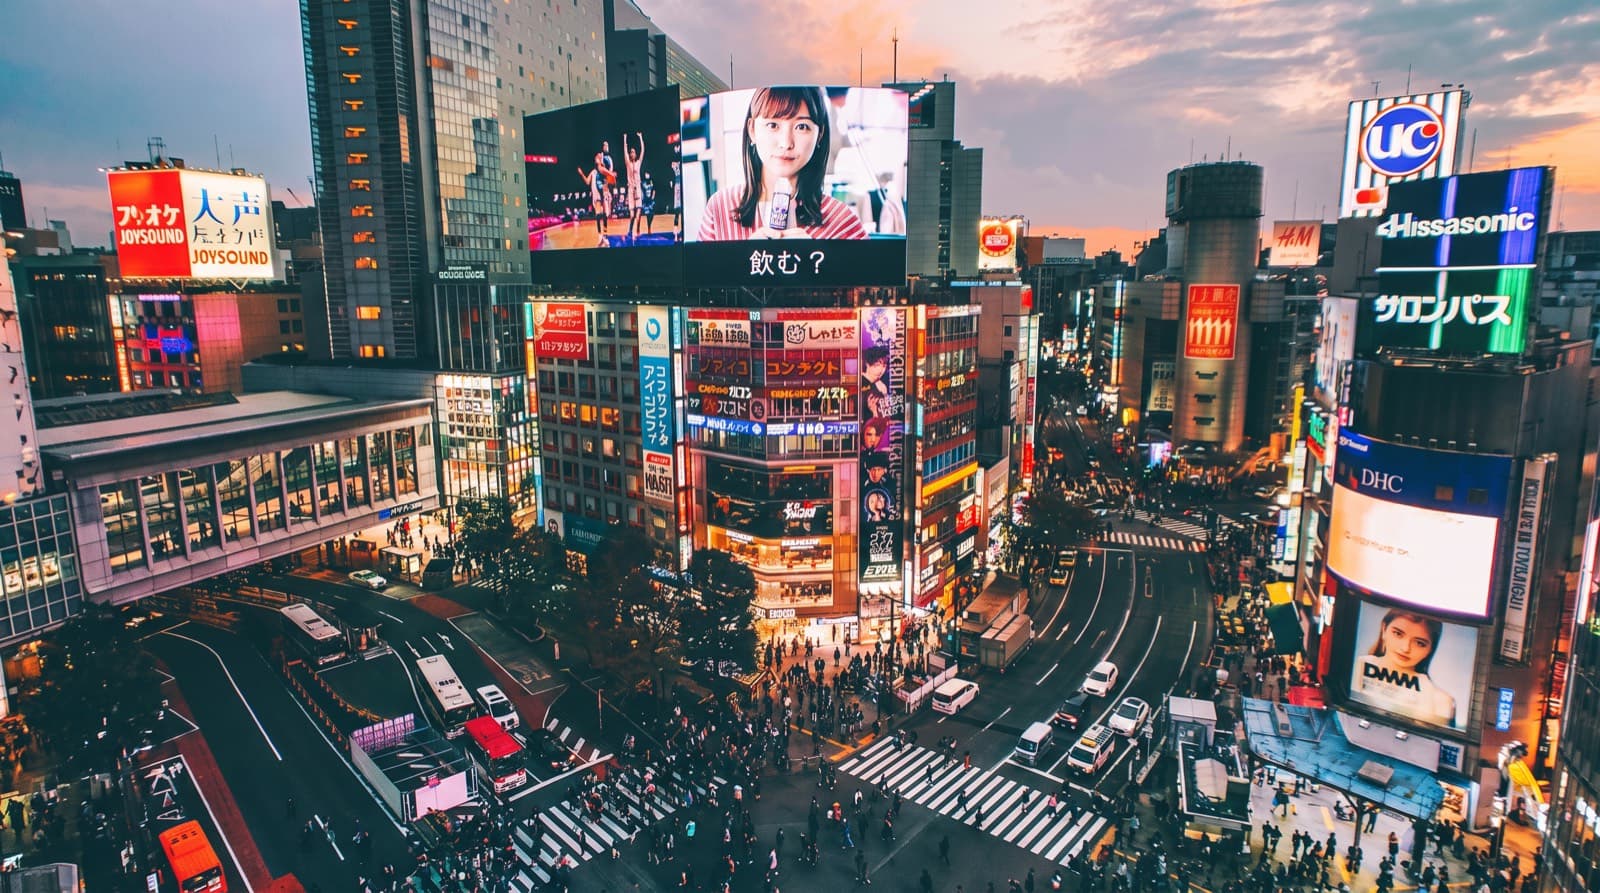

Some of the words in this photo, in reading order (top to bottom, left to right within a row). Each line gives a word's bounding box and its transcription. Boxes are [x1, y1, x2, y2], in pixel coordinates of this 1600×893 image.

[1378, 207, 1535, 239] Hissasonic
[120, 228, 184, 245] JOYSOUND
[192, 250, 269, 265] JOYSOUND
[1375, 294, 1512, 326] サロンパス
[1361, 468, 1404, 493] DHC
